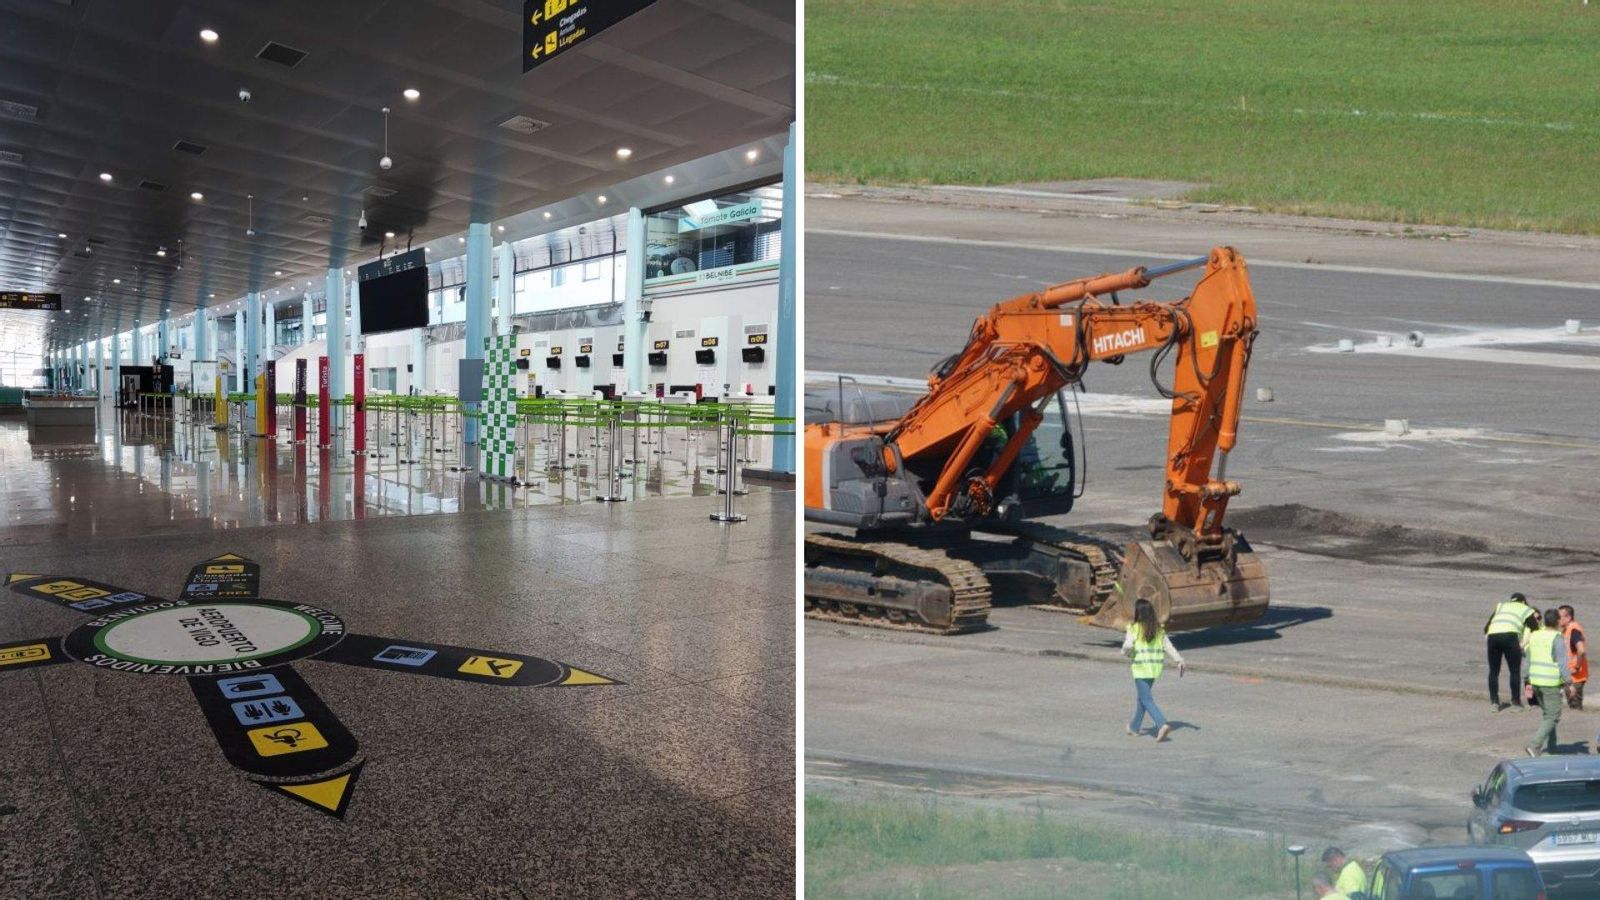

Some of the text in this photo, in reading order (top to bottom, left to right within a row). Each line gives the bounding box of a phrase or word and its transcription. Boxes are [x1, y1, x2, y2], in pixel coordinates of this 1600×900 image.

[560, 6, 587, 27] Chegadas
[730, 206, 757, 218] Galicia
[1093, 328, 1145, 354] HITACHI
[86, 600, 189, 627] BENVIDOS
[293, 604, 343, 636] WELCOME
[179, 617, 221, 647] DE VIGO
[197, 608, 259, 653] AEROPUERTO
[84, 653, 263, 675] BIENVENIDOS
